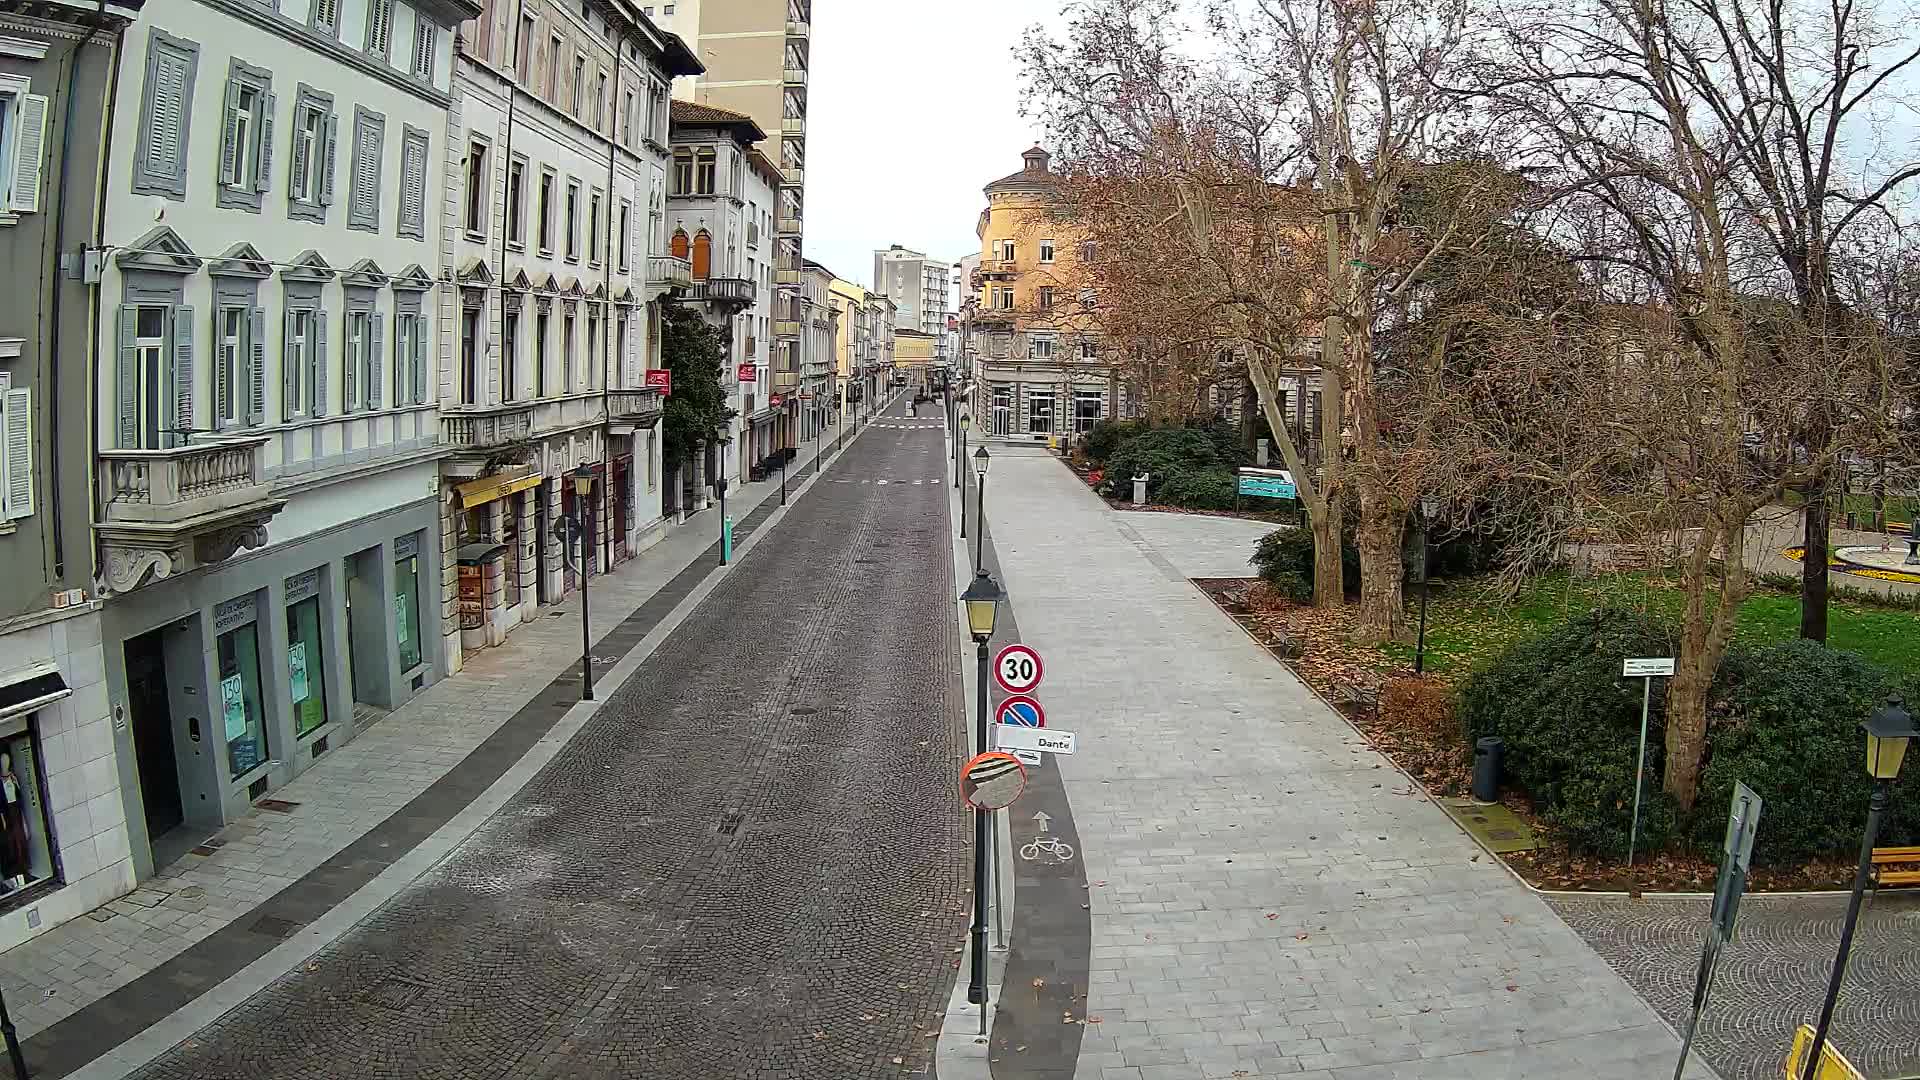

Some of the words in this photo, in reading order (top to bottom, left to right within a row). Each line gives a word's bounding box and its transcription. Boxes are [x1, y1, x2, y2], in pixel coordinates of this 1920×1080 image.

[1005, 658, 1033, 681] 30
[223, 678, 240, 700] 130
[1038, 738, 1070, 749] Dante
